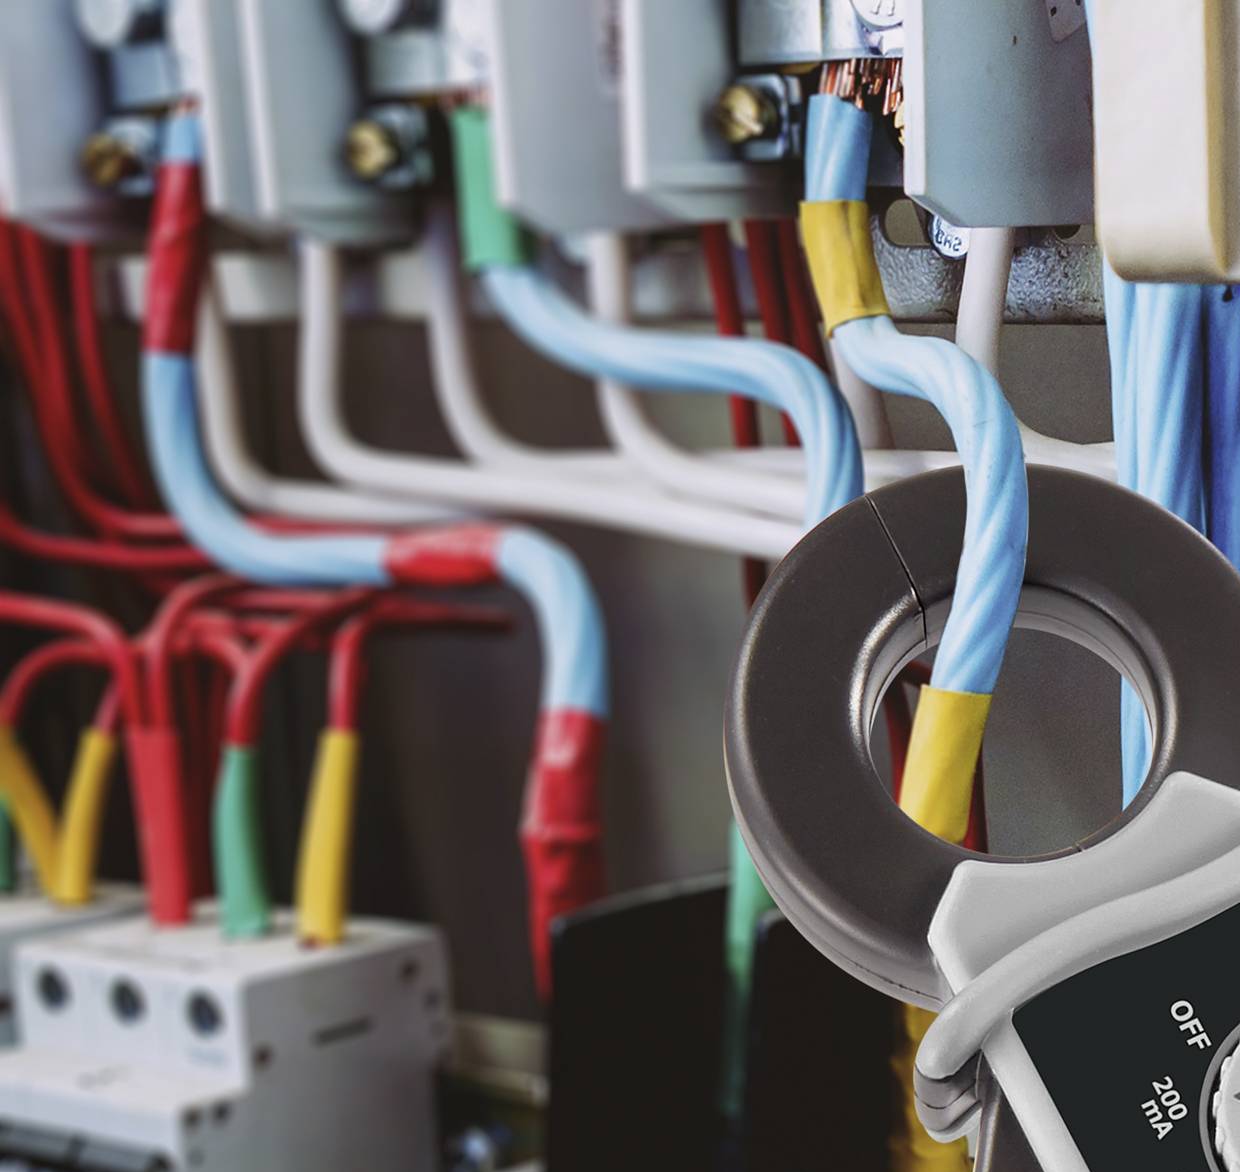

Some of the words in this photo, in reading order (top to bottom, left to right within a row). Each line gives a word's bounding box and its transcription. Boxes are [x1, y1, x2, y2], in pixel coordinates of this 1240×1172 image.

[1170, 1000, 1212, 1050] OFF
[1140, 1099, 1174, 1140] mA
[1151, 1075, 1188, 1121] 200
